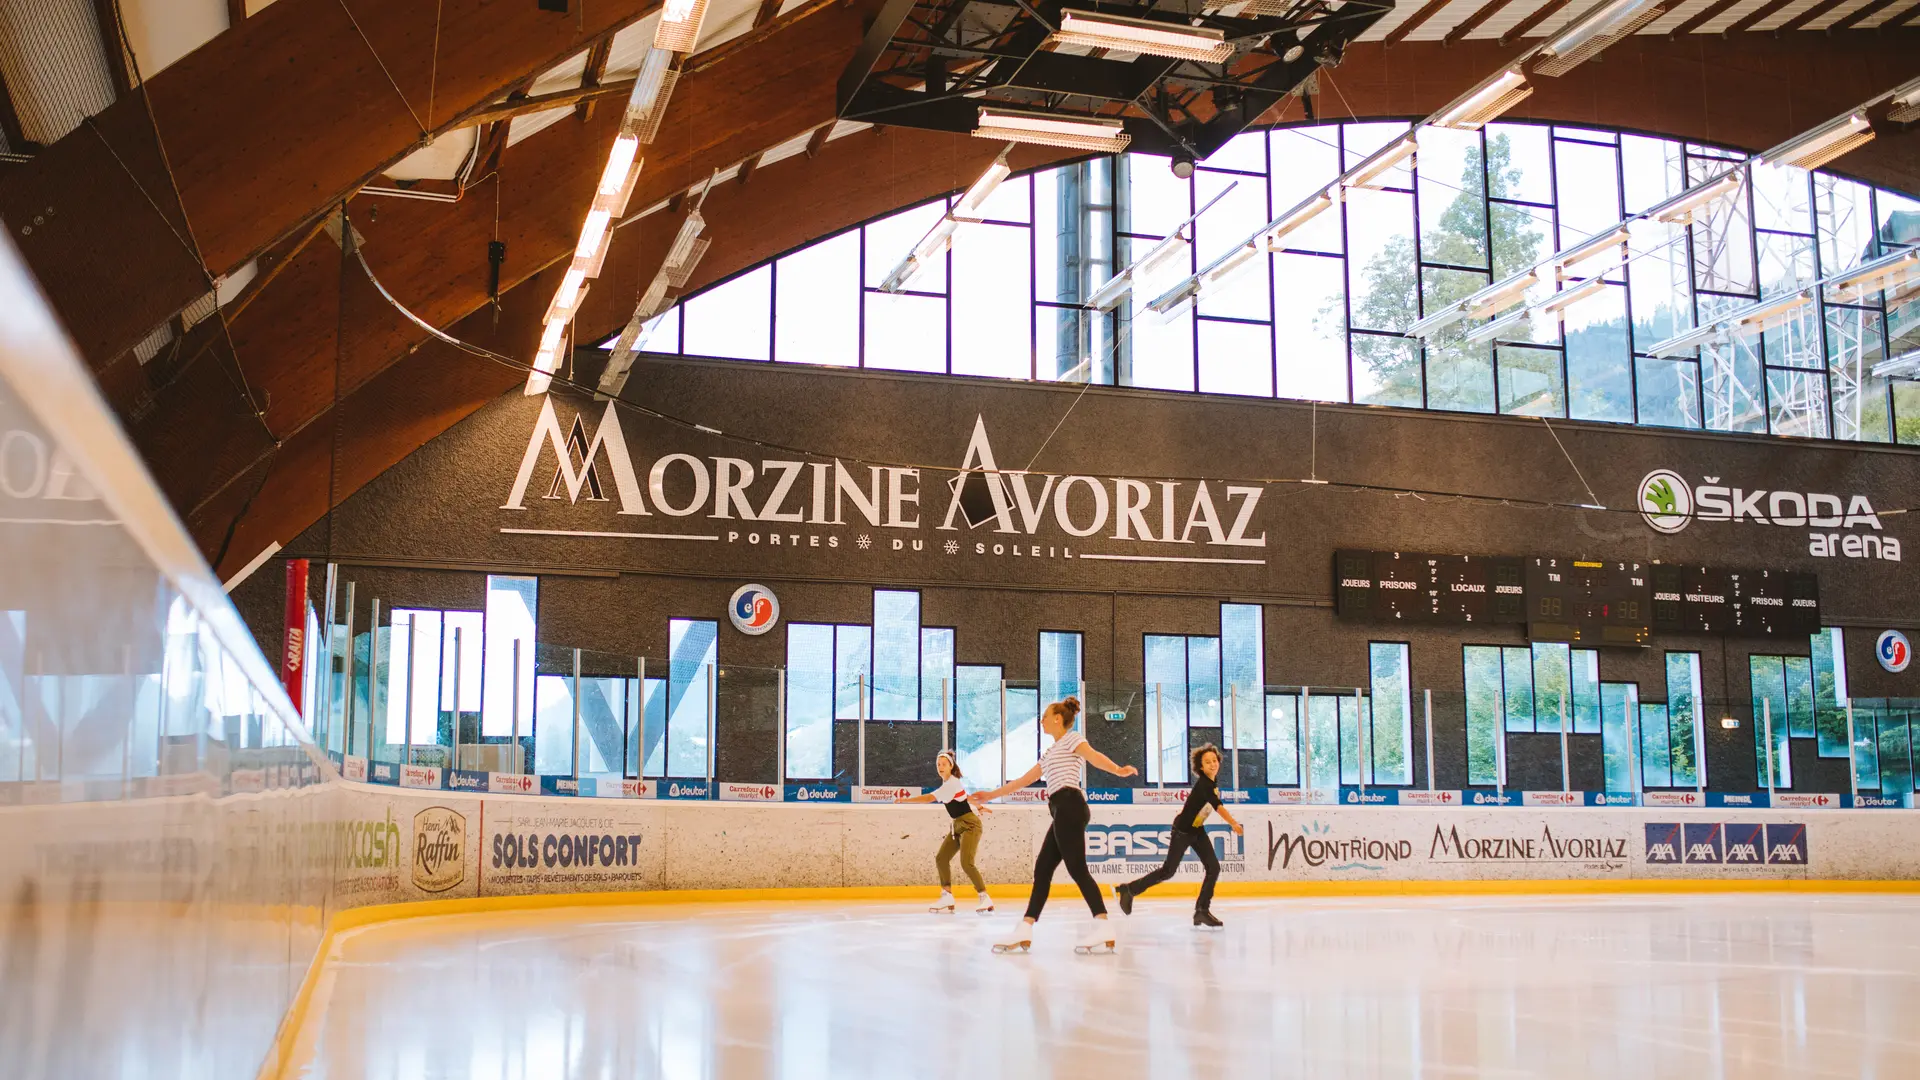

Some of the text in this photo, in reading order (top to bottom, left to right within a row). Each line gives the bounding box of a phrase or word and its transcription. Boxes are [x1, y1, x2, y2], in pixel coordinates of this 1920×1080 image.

[499, 394, 1266, 547] MORZINE AVORIAZ
[1695, 476, 1883, 530] ŠKODA
[728, 531, 1072, 559] PORTES DU SOLEIL
[1809, 533, 1901, 562] arena
[1550, 559, 1556, 567] 2
[1619, 563, 1625, 571] 3
[1547, 573, 1560, 582] TM
[1631, 578, 1643, 586] TM
[1341, 579, 1371, 588] JOUEURS
[1379, 581, 1417, 590] PRISONS
[1451, 584, 1486, 593] LOCAUX
[1495, 585, 1523, 594] JOUEURS
[1654, 592, 1681, 601] JOUEURS
[1685, 594, 1725, 603] VISITEURS
[1751, 597, 1783, 606] PRISONS
[1791, 599, 1817, 607] JOUEURS
[680, 786, 708, 797] deuter
[729, 785, 759, 793] Carrefour
[808, 789, 838, 799] deuter
[1089, 791, 1119, 800] deuter
[1359, 794, 1386, 802] deuter
[1866, 798, 1897, 806] deuter
[422, 816, 441, 831] Henri
[1429, 823, 1627, 859] MORZINE AVORIAZ
[416, 831, 460, 875] Raffin
[492, 833, 641, 868] SOLS CONFORT
[1646, 843, 1676, 861] AXA
[1685, 843, 1717, 861] AXA
[1726, 844, 1758, 861] AXA
[1768, 844, 1801, 861] AXA
